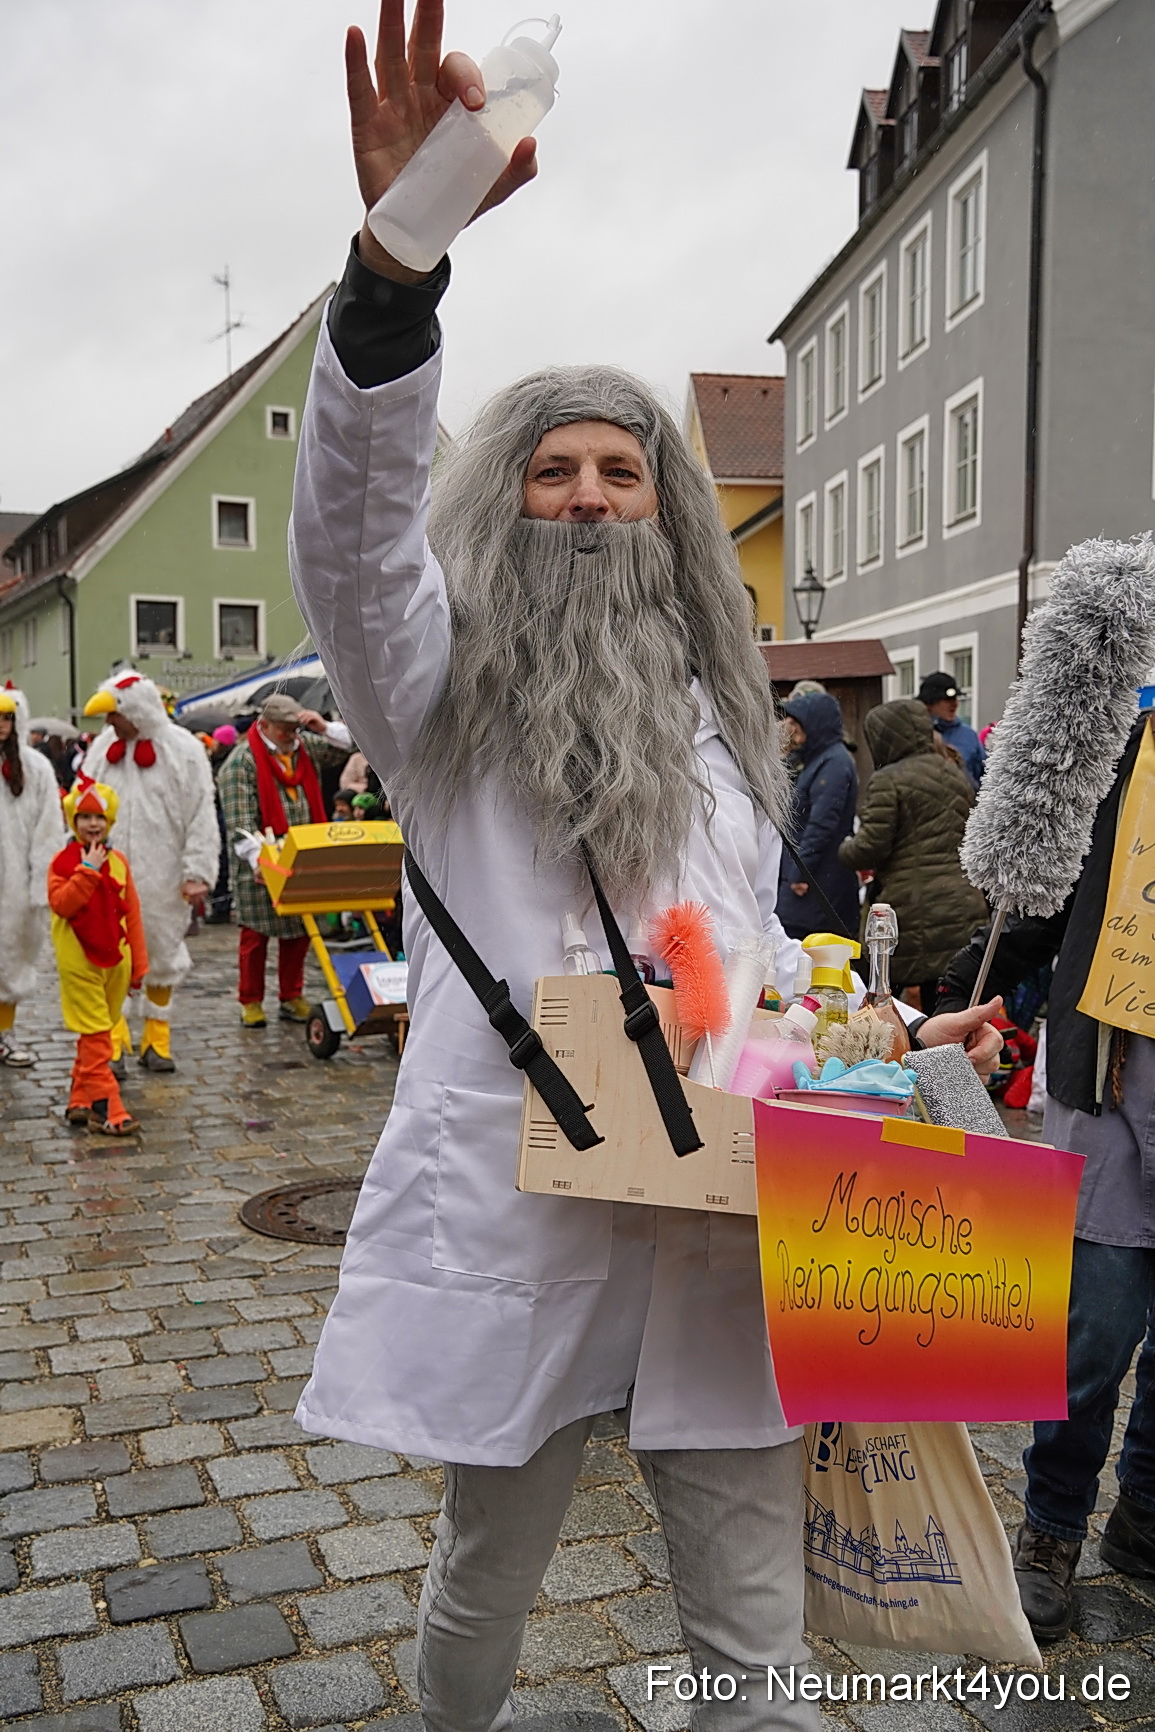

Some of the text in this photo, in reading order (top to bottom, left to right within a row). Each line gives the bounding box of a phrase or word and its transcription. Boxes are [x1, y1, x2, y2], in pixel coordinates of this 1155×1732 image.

[1106, 914, 1139, 937] ab
[812, 1171, 973, 1264] Magische
[776, 1240, 1035, 1348] Reinigungsmittel
